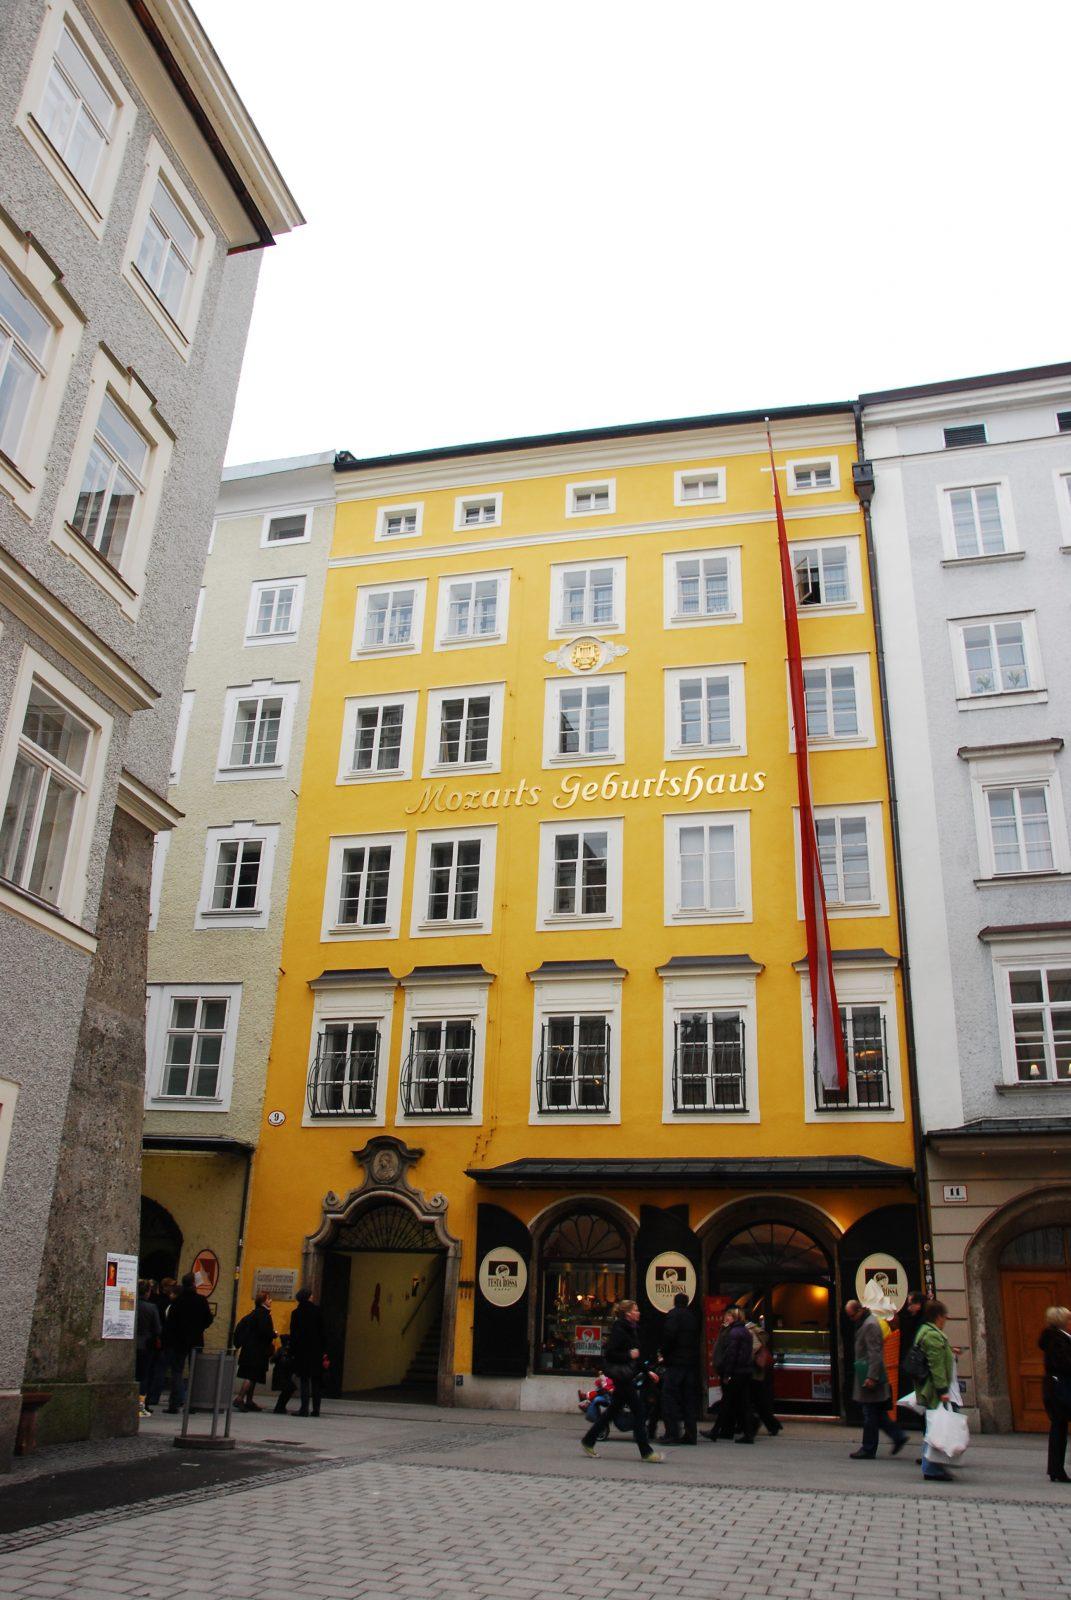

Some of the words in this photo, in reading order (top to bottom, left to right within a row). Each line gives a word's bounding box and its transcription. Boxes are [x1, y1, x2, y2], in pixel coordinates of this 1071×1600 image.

[404, 779, 543, 815] Mozarts
[552, 765, 767, 809] Geburtshaus
[274, 1112, 280, 1121] 9
[950, 1187, 960, 1196] 11
[488, 1278, 502, 1287] TESTA
[503, 1278, 518, 1288] ROSSA
[655, 1283, 671, 1293] TESTA
[671, 1284, 686, 1293] ROSSA
